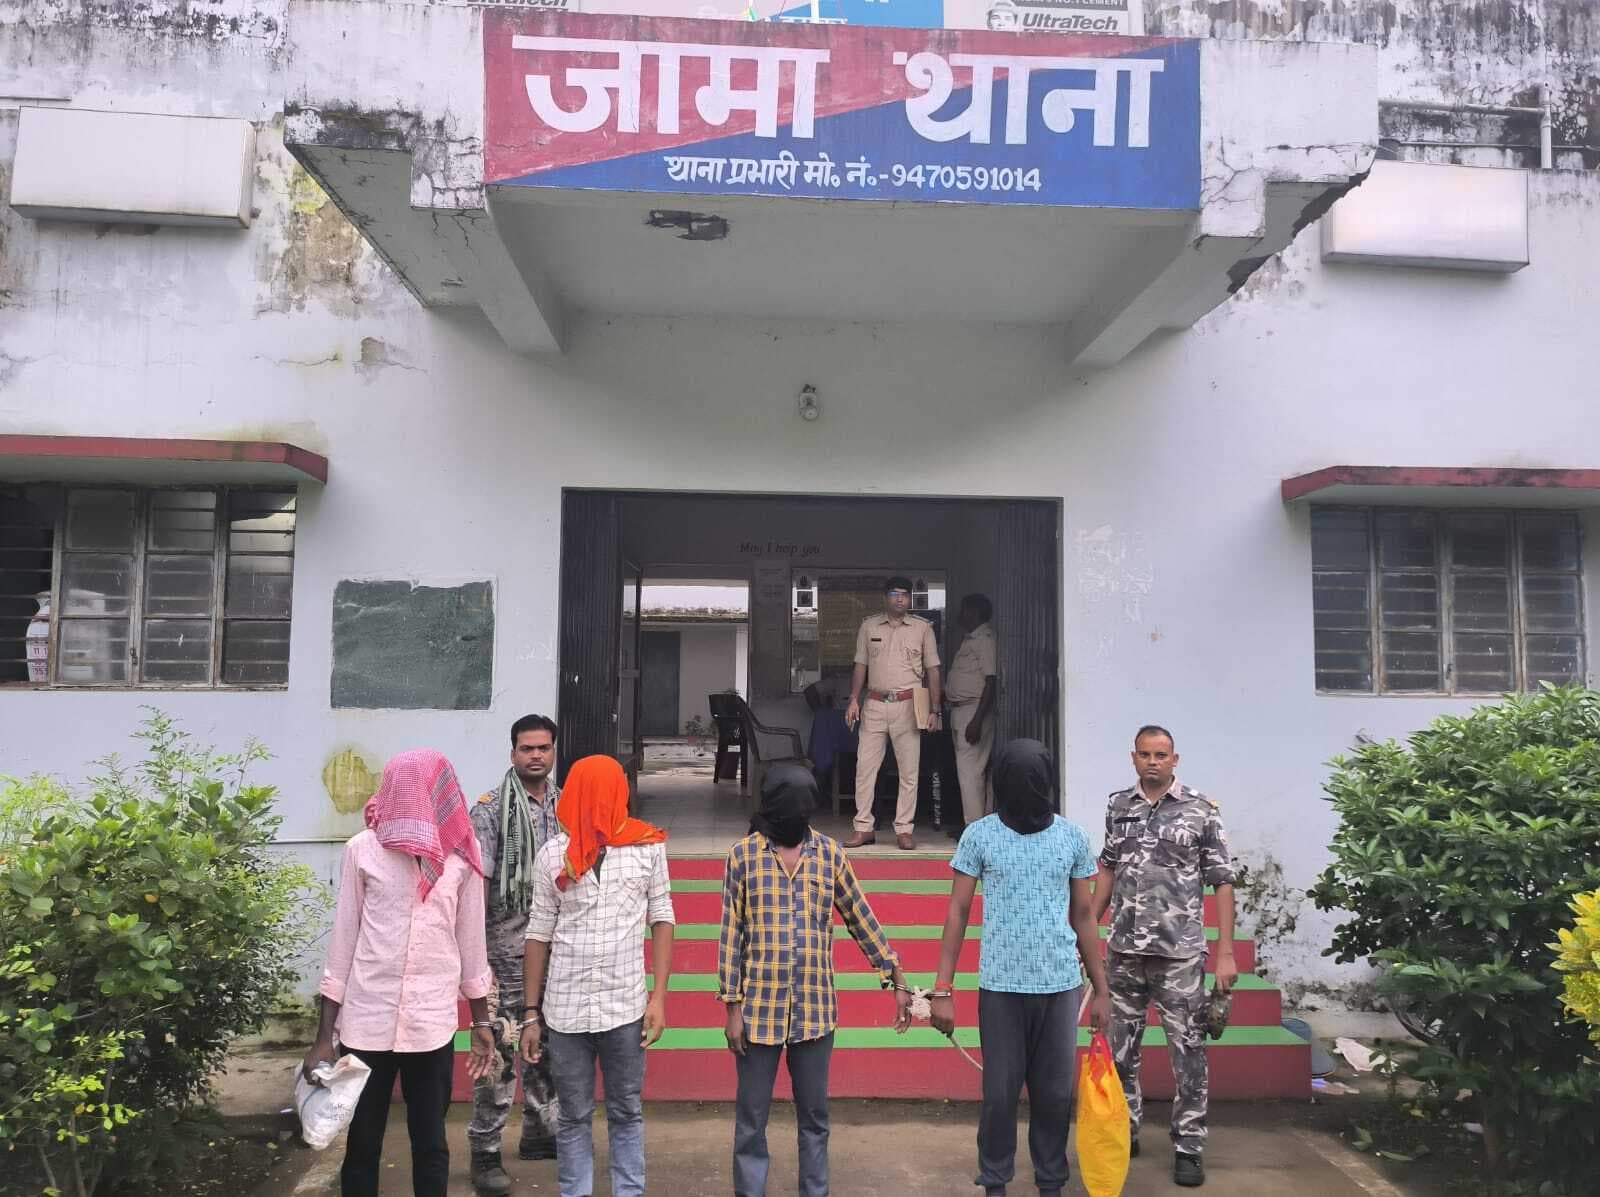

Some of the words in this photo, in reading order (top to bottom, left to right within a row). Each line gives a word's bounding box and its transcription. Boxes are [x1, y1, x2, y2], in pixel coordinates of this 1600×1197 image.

[1023, 12, 1118, 31] UltraTech
[511, 34, 831, 139] जामा
[892, 51, 1165, 147] थाना
[663, 155, 727, 184] थाना
[726, 149, 800, 190] प्रभारी
[739, 542, 763, 557] May
[801, 544, 821, 558] you
